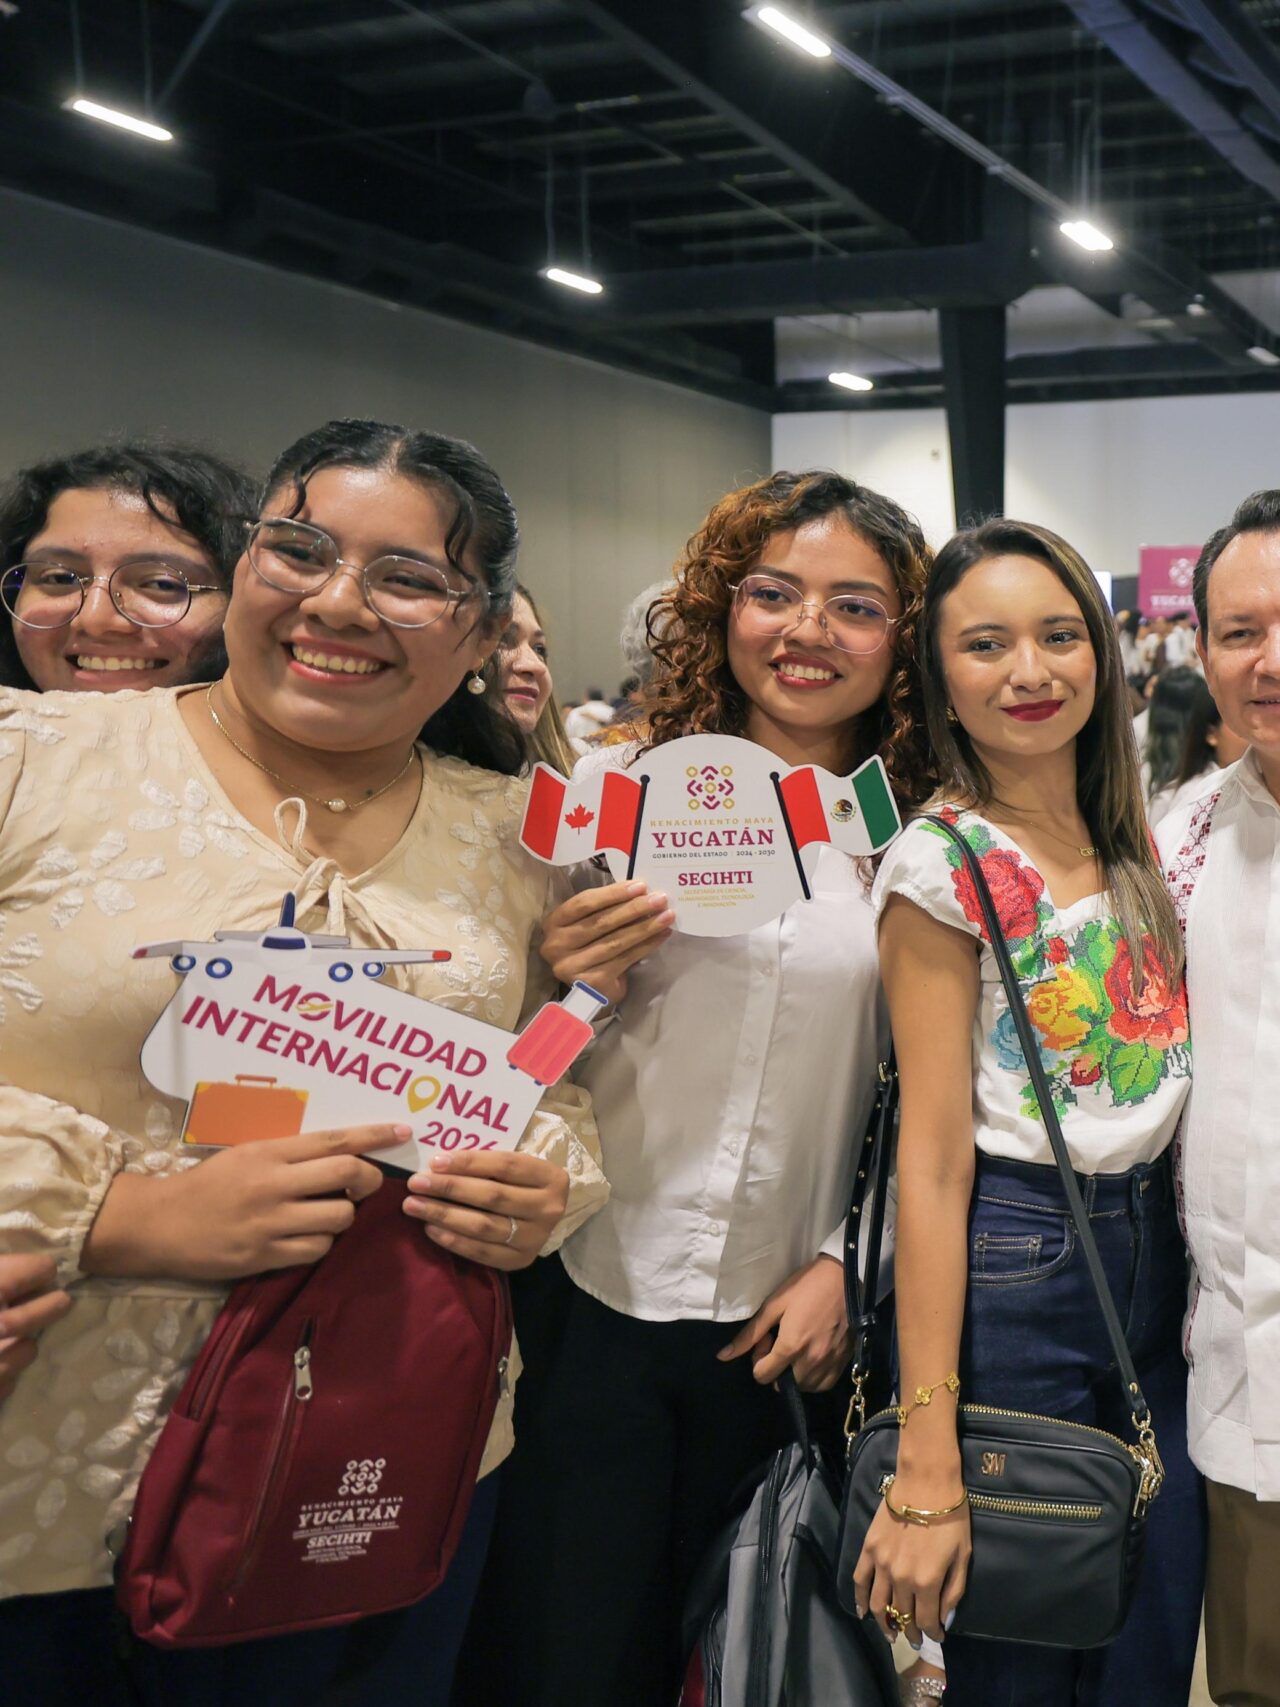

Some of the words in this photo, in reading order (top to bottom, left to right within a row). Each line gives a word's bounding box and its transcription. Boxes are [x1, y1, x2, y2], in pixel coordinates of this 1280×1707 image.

[650, 817, 738, 827] RENACIMIENTO
[744, 816, 774, 824] MAYA
[651, 826, 774, 848] YUCATÁN
[678, 871, 753, 886] SECIHTI
[253, 975, 487, 1078] MOVILIDAD
[181, 996, 511, 1133] INTERNACIONAL
[298, 1504, 401, 1528] YUCATÁN
[306, 1531, 372, 1549] SECIHTI
